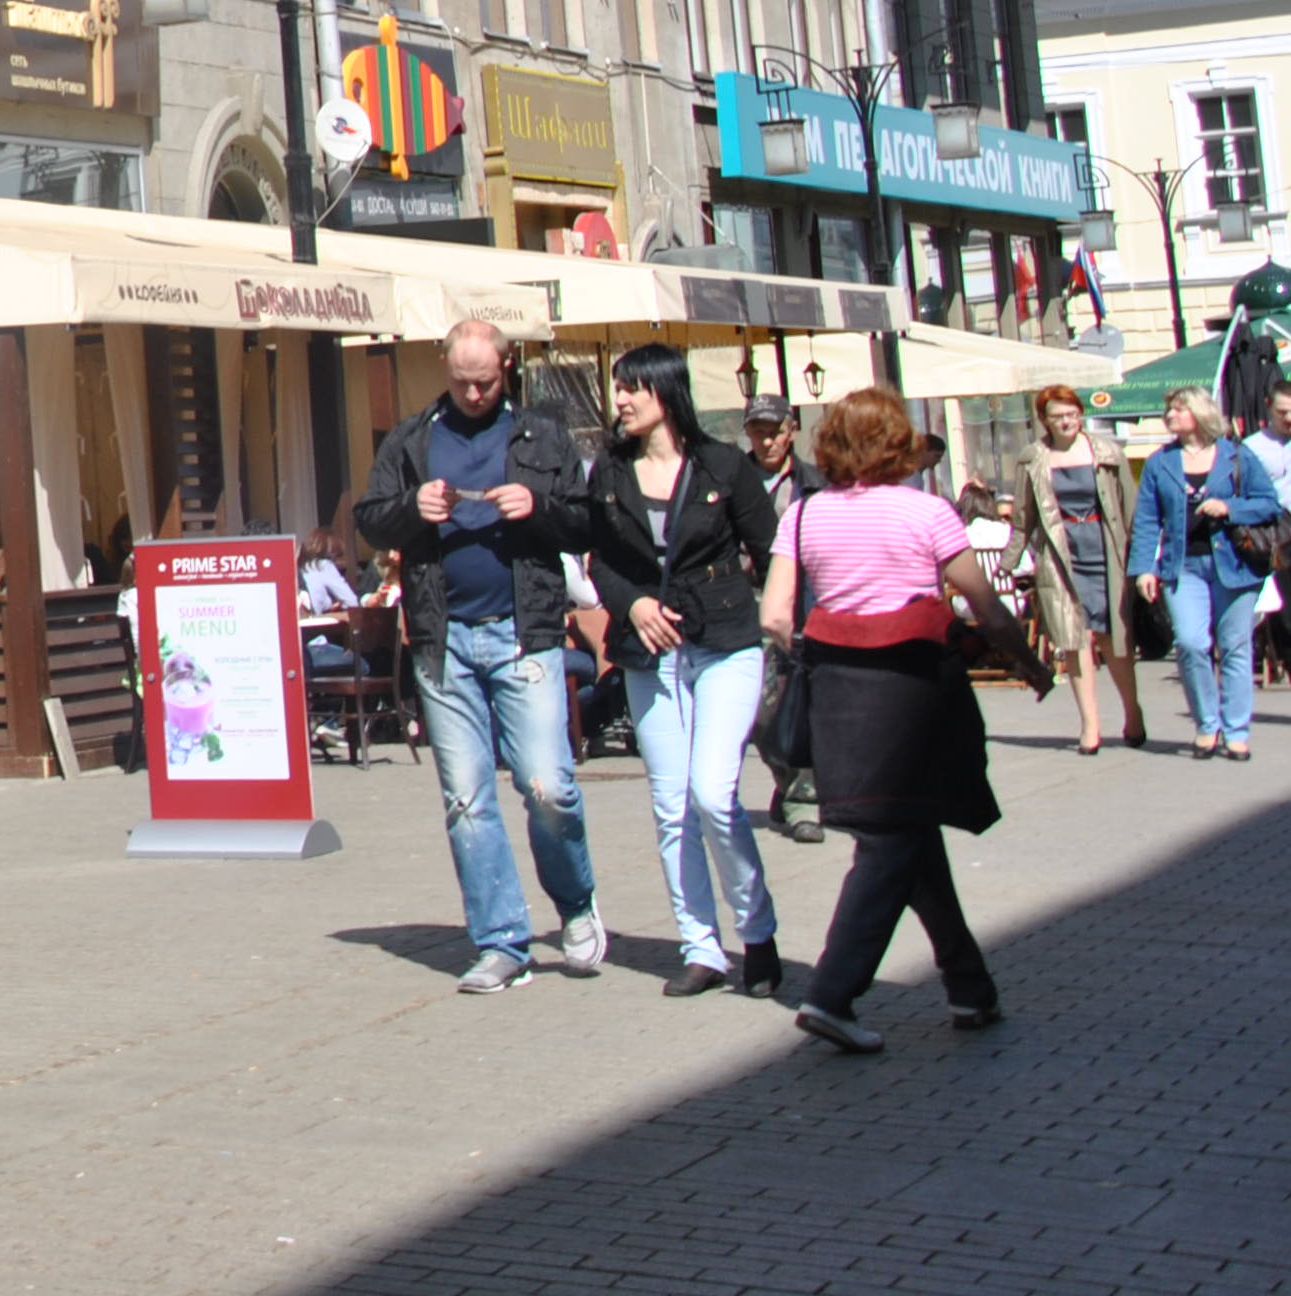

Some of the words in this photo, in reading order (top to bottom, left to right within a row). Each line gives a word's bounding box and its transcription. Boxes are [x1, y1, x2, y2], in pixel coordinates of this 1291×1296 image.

[833, 120, 1013, 194] ПЕАГОГИЧЕСКОЙ
[1018, 155, 1073, 203] КНИГИ
[135, 284, 184, 304] КОФЕЙНЯ
[234, 278, 374, 324] ШОКОЛАДНИЦА
[172, 557, 217, 573] PRIME
[220, 554, 257, 572] STAR
[179, 605, 235, 618] SUMMER
[180, 619, 237, 637] MENU
